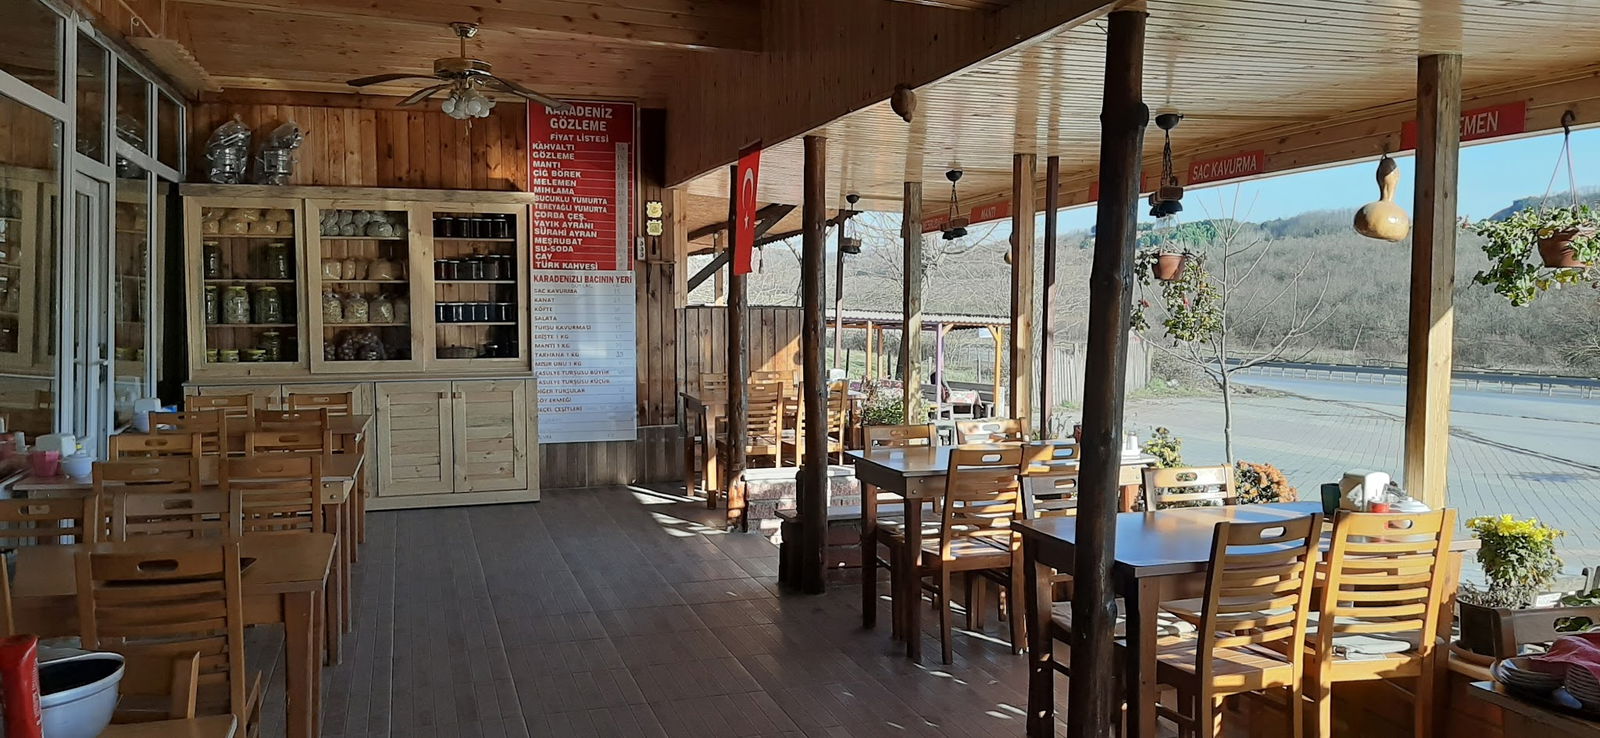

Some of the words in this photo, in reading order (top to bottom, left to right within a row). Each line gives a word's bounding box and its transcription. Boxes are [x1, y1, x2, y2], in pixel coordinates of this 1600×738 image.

[550, 116, 607, 131] GÖZLEME
[550, 132, 574, 141] FİYAT
[577, 133, 609, 143] LİSTESİ
[532, 151, 575, 160] GÖZLEME
[532, 161, 560, 169] MANTI
[1193, 164, 1210, 180] SAC
[1211, 155, 1257, 177] KAVURMA
[552, 169, 582, 178] BÖREK
[534, 178, 577, 187] MELEMEN
[534, 186, 574, 194] MIHLAMA
[572, 196, 608, 204] YUMURTA
[535, 203, 572, 211] TEREYAĞLI
[534, 211, 565, 219] ÇORBA
[562, 222, 594, 230] AYRANI
[534, 227, 566, 235] SÜRAHİ
[536, 260, 560, 269] TÜRK
[562, 261, 597, 270] KAHVESİ
[616, 275, 632, 284] YERİ
